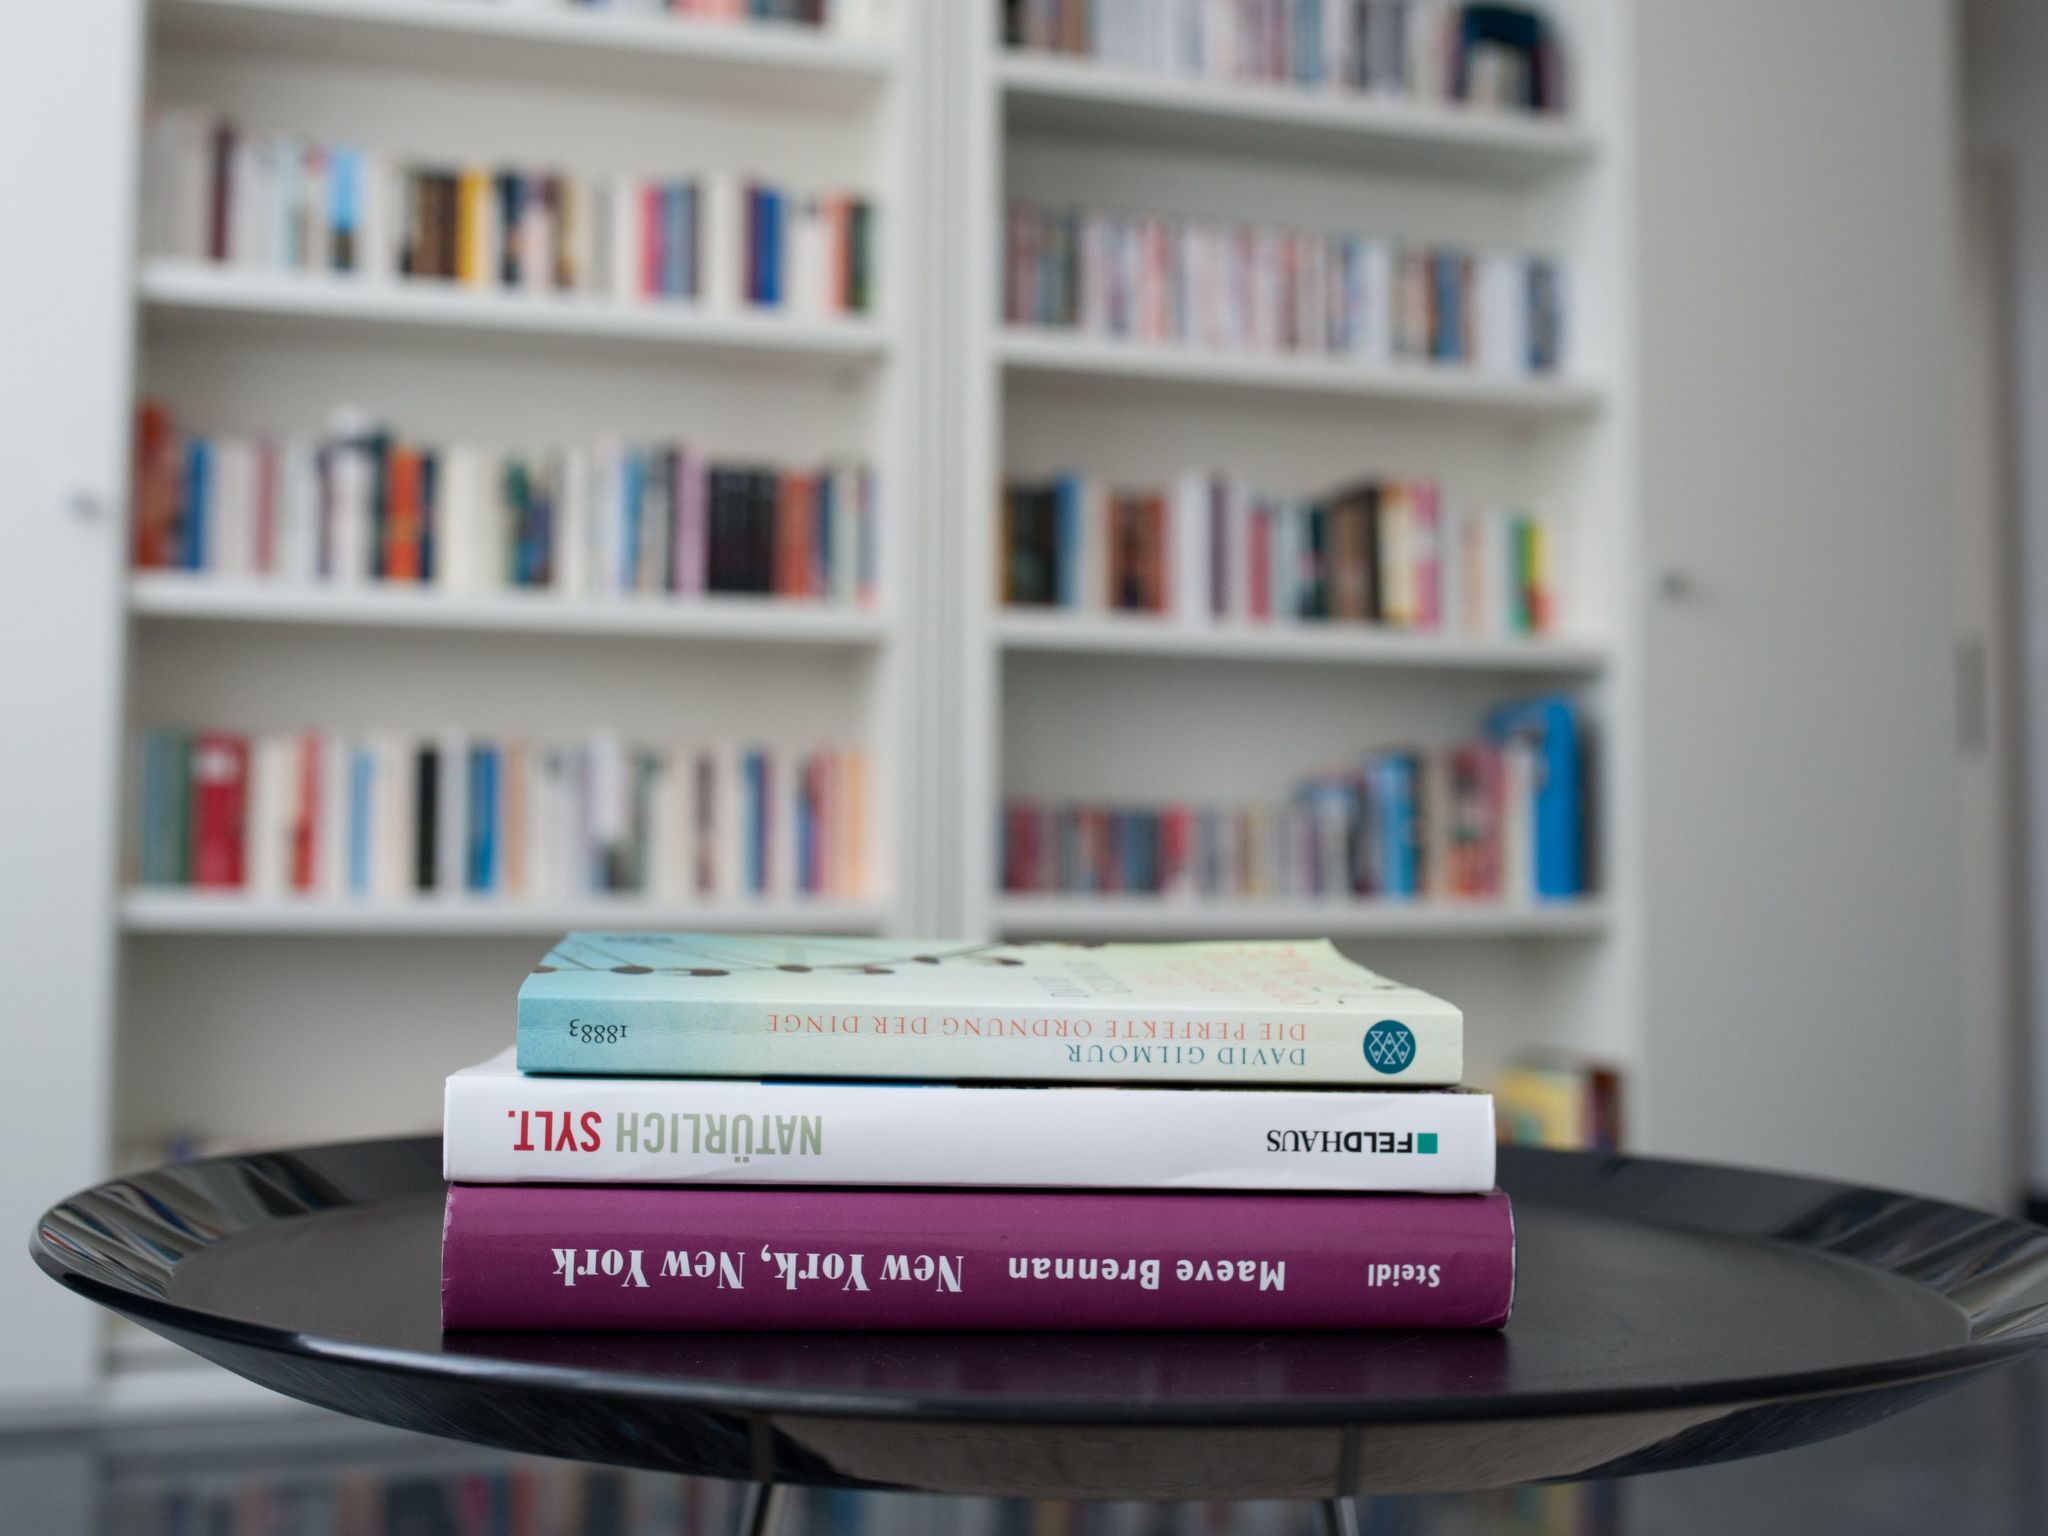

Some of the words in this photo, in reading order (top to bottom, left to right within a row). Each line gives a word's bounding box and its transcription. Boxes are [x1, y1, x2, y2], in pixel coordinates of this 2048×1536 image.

[569, 1018, 628, 1044] 18883
[766, 1014, 860, 1034] DINGE
[872, 1015, 929, 1035] DER
[942, 1017, 1093, 1038] ORDNUNG
[1106, 1020, 1245, 1041] PERFEKTE
[1259, 1023, 1306, 1041] DIE
[1066, 1044, 1205, 1065] GILMOUR
[1217, 1047, 1306, 1066] DAVID
[507, 1110, 602, 1153] SYLT.
[615, 1112, 822, 1163] NATÜRLICH
[1266, 1129, 1413, 1154] FELDHAUS
[551, 1248, 650, 1288] York
[659, 1250, 746, 1290] New
[760, 1244, 871, 1292] York,
[879, 1253, 964, 1293] New
[1008, 1257, 1160, 1290] Brennan
[1176, 1259, 1286, 1292] Maeve
[1367, 1263, 1441, 1288] Steidl
